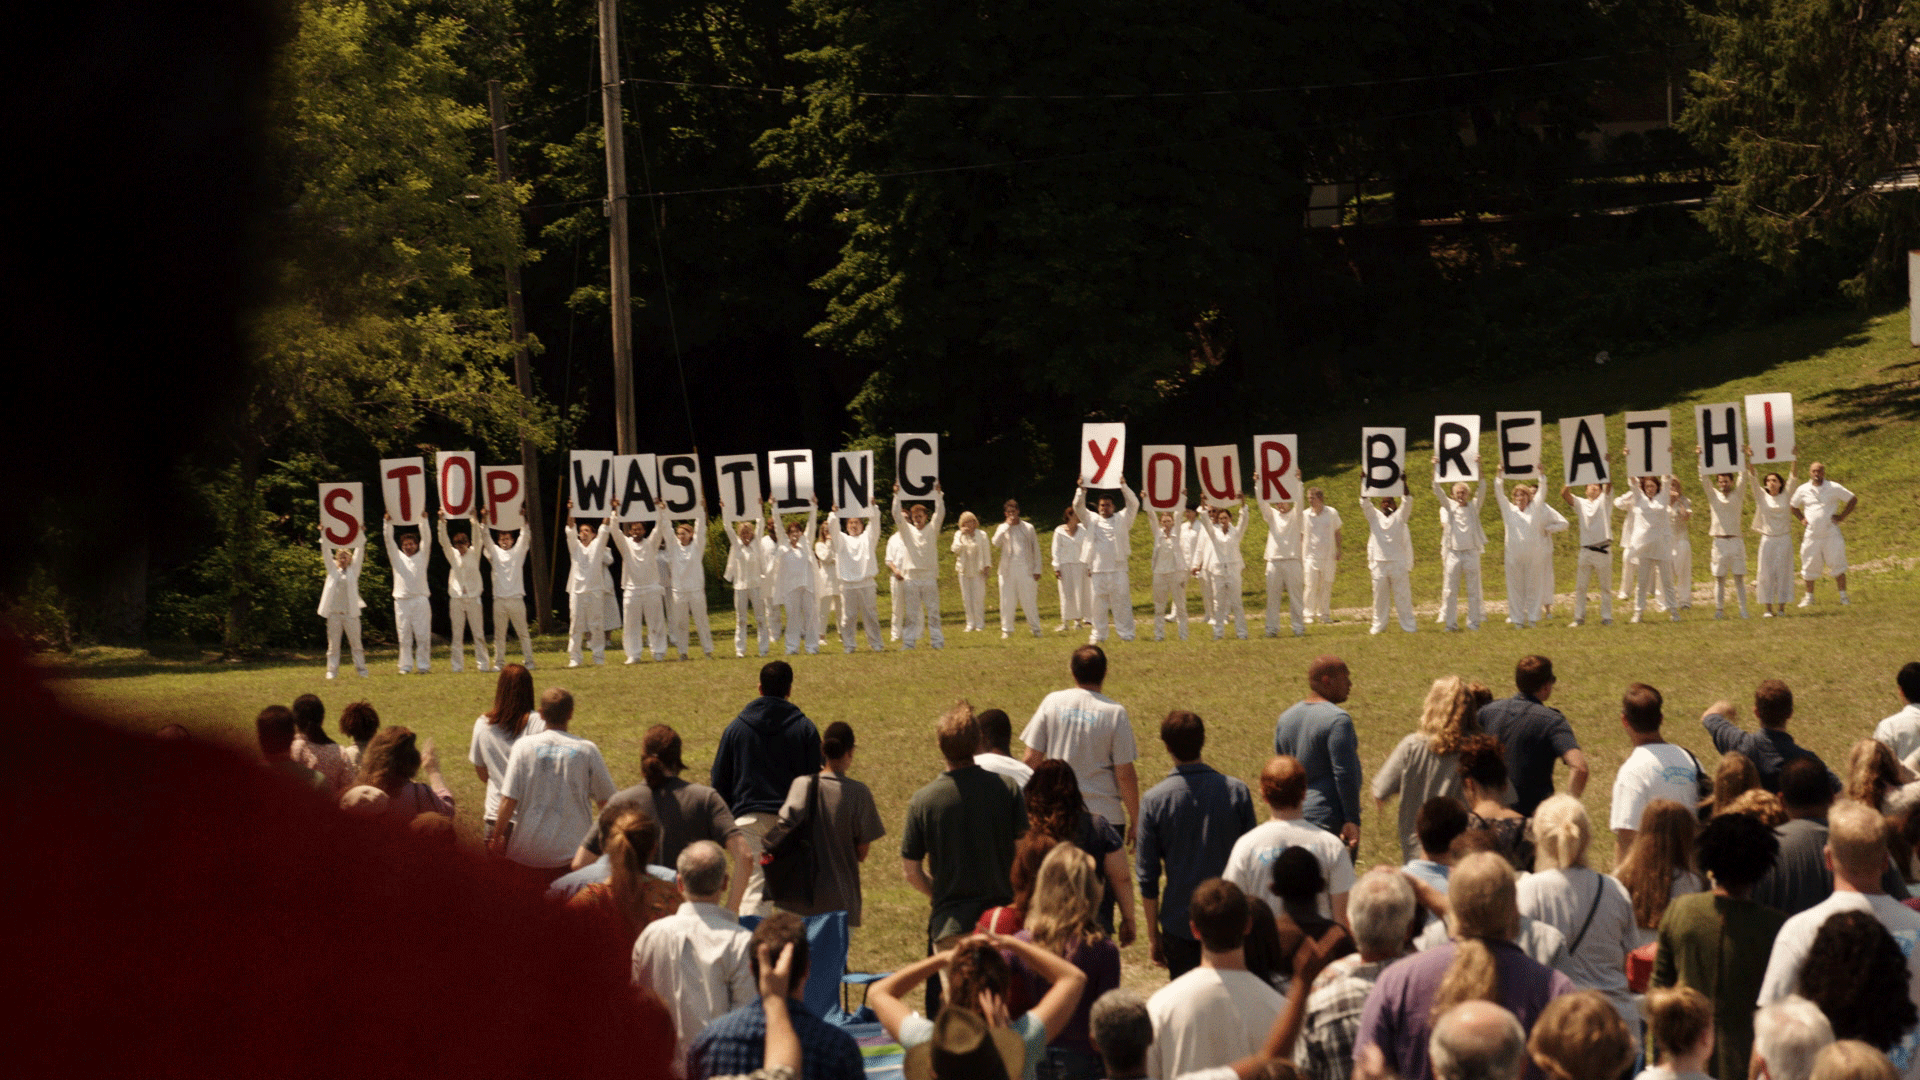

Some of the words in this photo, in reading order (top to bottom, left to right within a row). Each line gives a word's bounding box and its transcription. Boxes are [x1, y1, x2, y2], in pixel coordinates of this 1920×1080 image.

[324, 456, 519, 545] STOP
[573, 438, 936, 517] WASTING
[1088, 437, 1292, 508] YOUR
[1365, 401, 1776, 490] BREATH!
